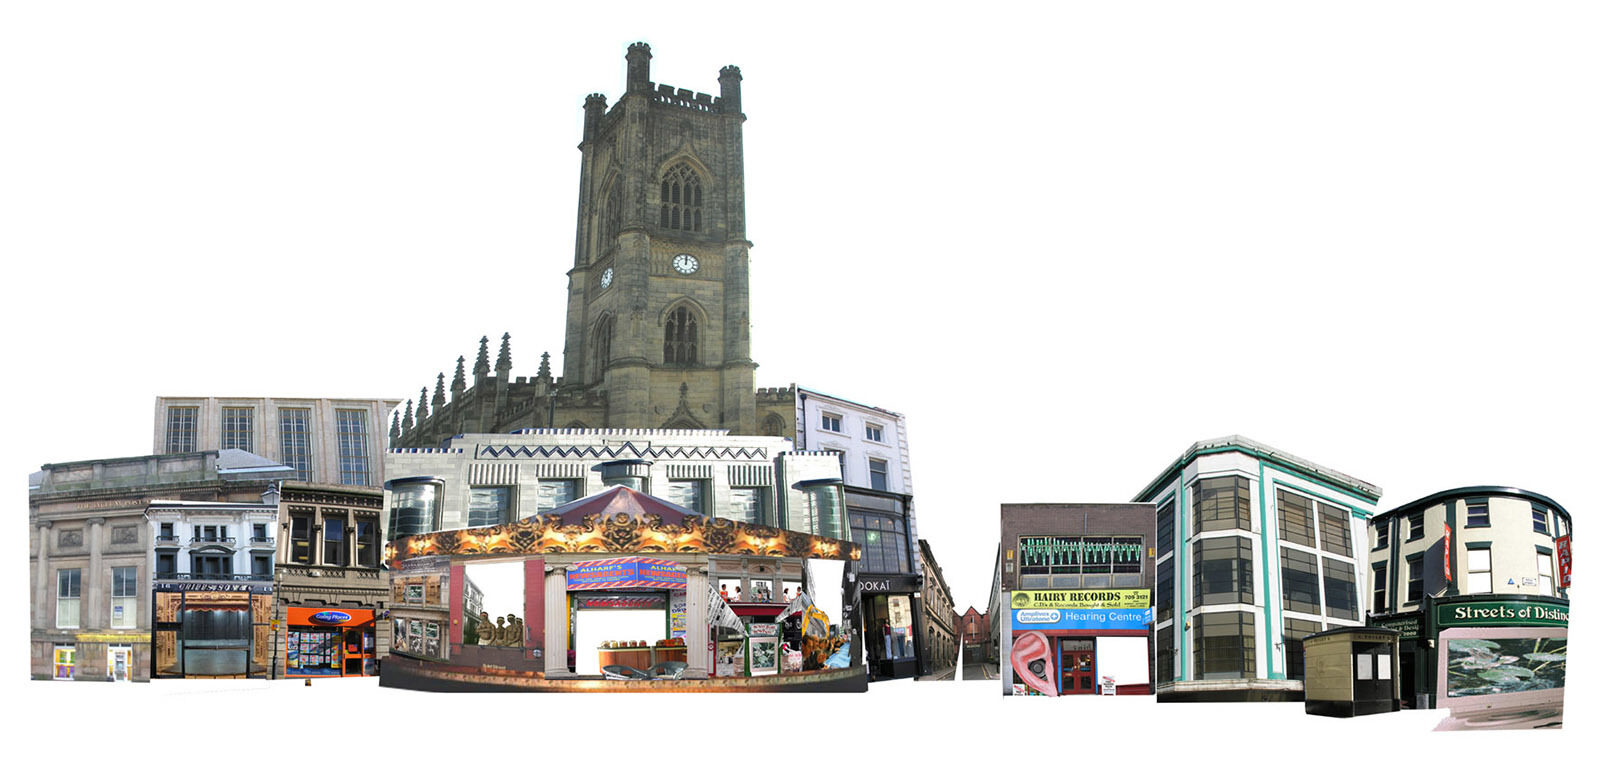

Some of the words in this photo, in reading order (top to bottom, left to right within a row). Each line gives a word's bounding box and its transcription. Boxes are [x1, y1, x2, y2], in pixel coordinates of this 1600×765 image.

[569, 569, 634, 579] NEWSAGENTS
[1034, 592, 1066, 601] HAIRY
[1070, 592, 1120, 601] RECORDS
[1065, 611, 1105, 623] Hearing
[1109, 612, 1142, 621] Centre
[1455, 606, 1515, 619] Streets
[1518, 606, 1531, 618] of
